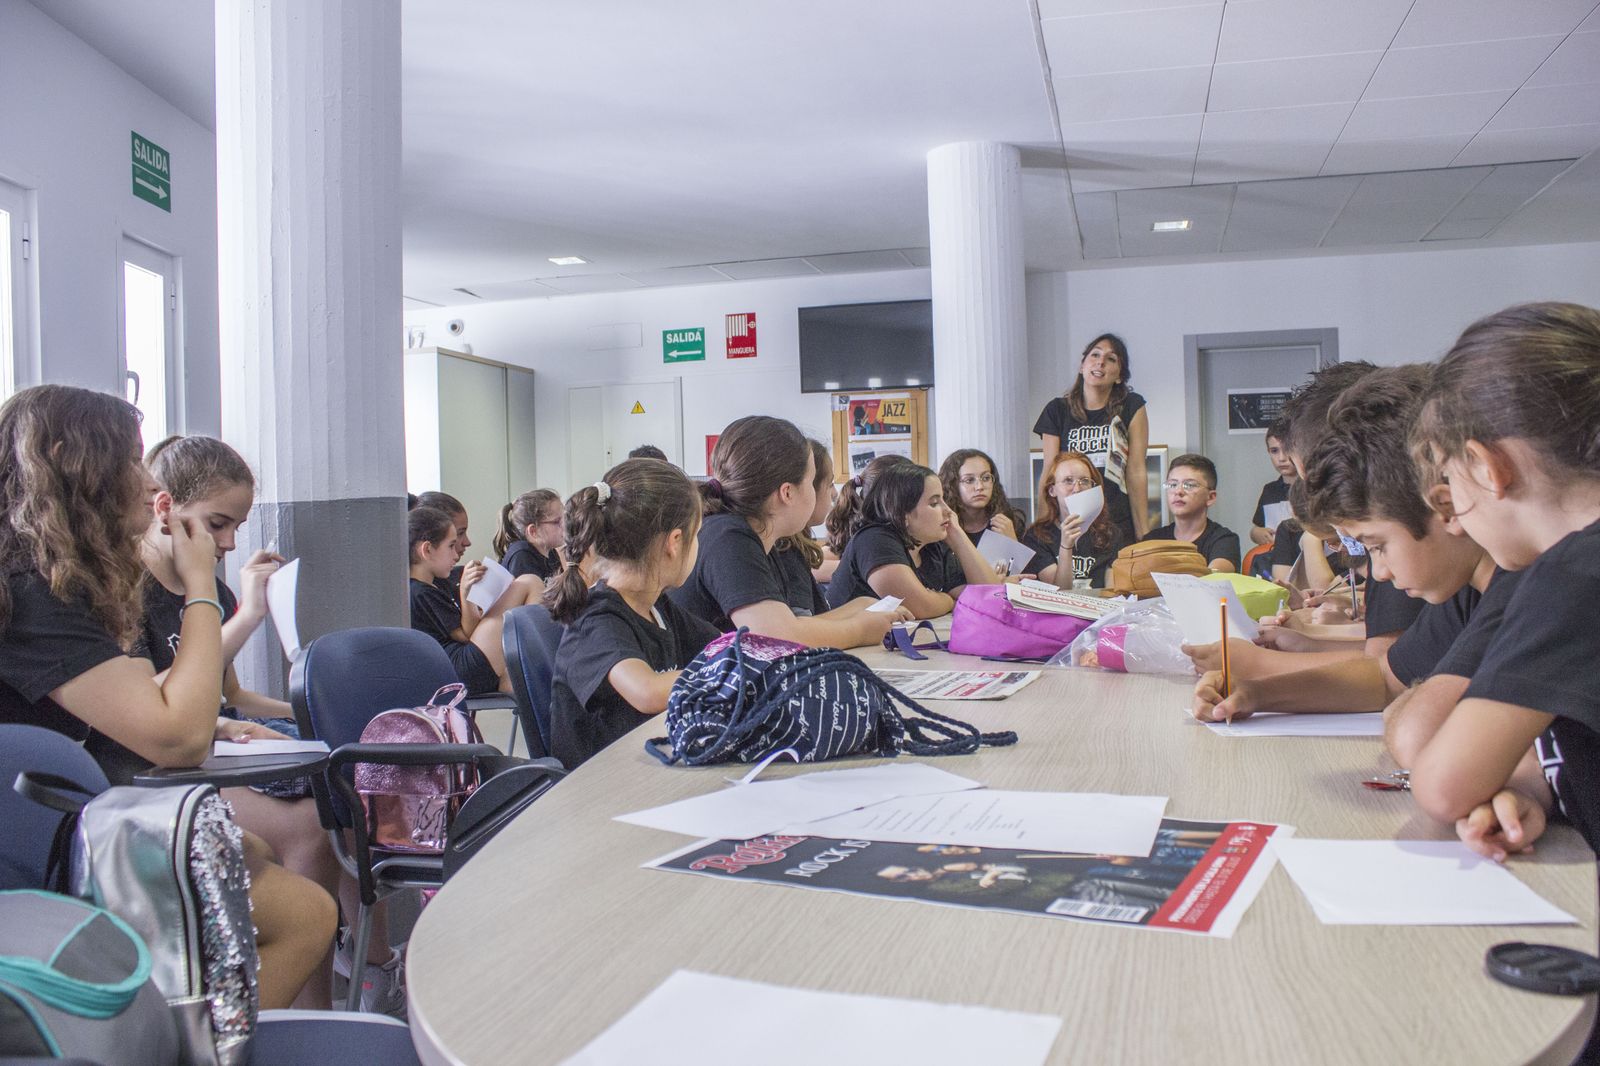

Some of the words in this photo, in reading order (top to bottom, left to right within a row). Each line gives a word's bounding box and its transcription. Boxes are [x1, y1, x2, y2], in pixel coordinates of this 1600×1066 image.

[133, 138, 169, 175] SALIDA
[666, 331, 702, 344] SALIDA
[728, 346, 755, 355] MANGUERA
[881, 402, 906, 418] JAZZ
[784, 847, 858, 877] ROCK
